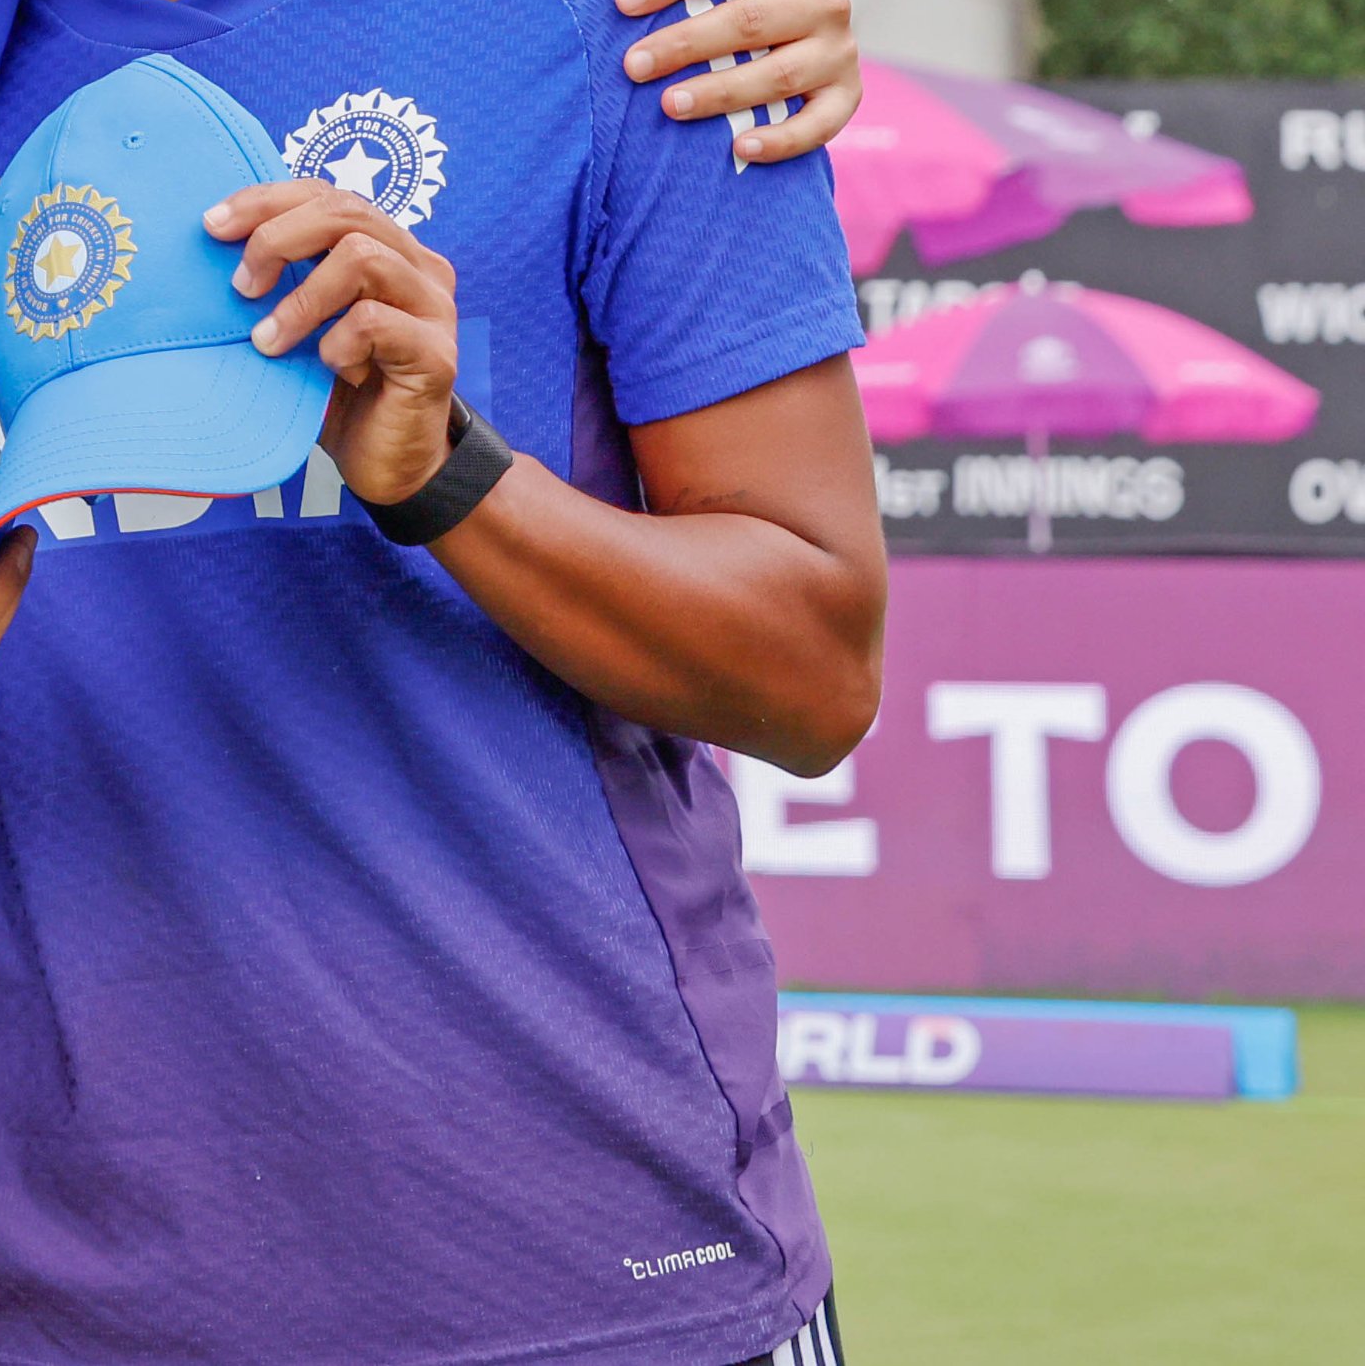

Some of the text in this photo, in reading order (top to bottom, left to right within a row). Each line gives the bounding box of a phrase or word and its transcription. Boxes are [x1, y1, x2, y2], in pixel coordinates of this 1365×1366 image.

[355, 119, 382, 133] FOR
[304, 123, 352, 168] CONTROL
[381, 127, 413, 171] CRICKET
[396, 173, 412, 188] IN
[48, 212, 68, 225] FOR
[71, 213, 105, 245] CRICKET
[95, 248, 106, 261] IN
[78, 264, 103, 295] INDIA
[925, 679, 1324, 889] TO
[777, 1010, 984, 1087] RLD
